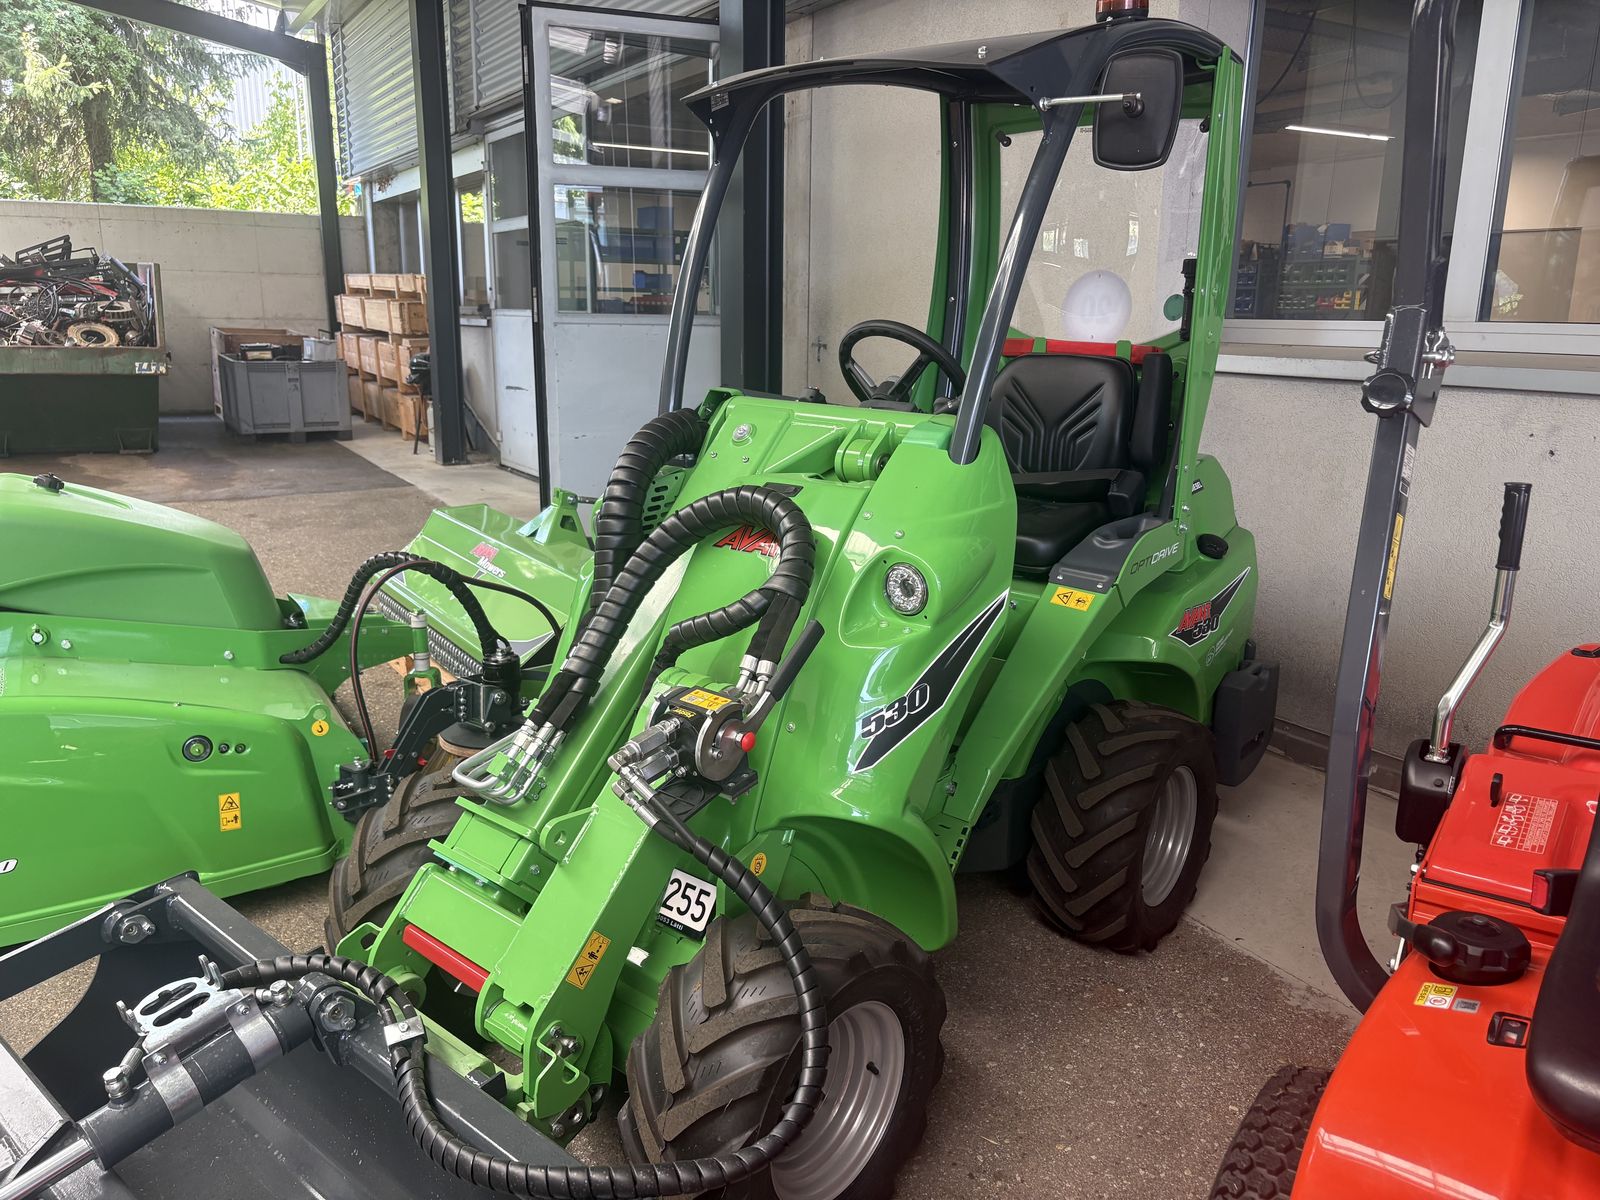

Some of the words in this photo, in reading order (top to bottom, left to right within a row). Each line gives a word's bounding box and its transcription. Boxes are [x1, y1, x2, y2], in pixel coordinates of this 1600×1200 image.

[477, 556, 507, 578] Mowers
[1130, 542, 1180, 575] OPTIDRIVE
[1177, 601, 1212, 634] AVANT
[1192, 614, 1220, 639] 530
[855, 683, 930, 740] 530
[661, 877, 711, 923] 255
[1416, 984, 1431, 1002] DIESEL
